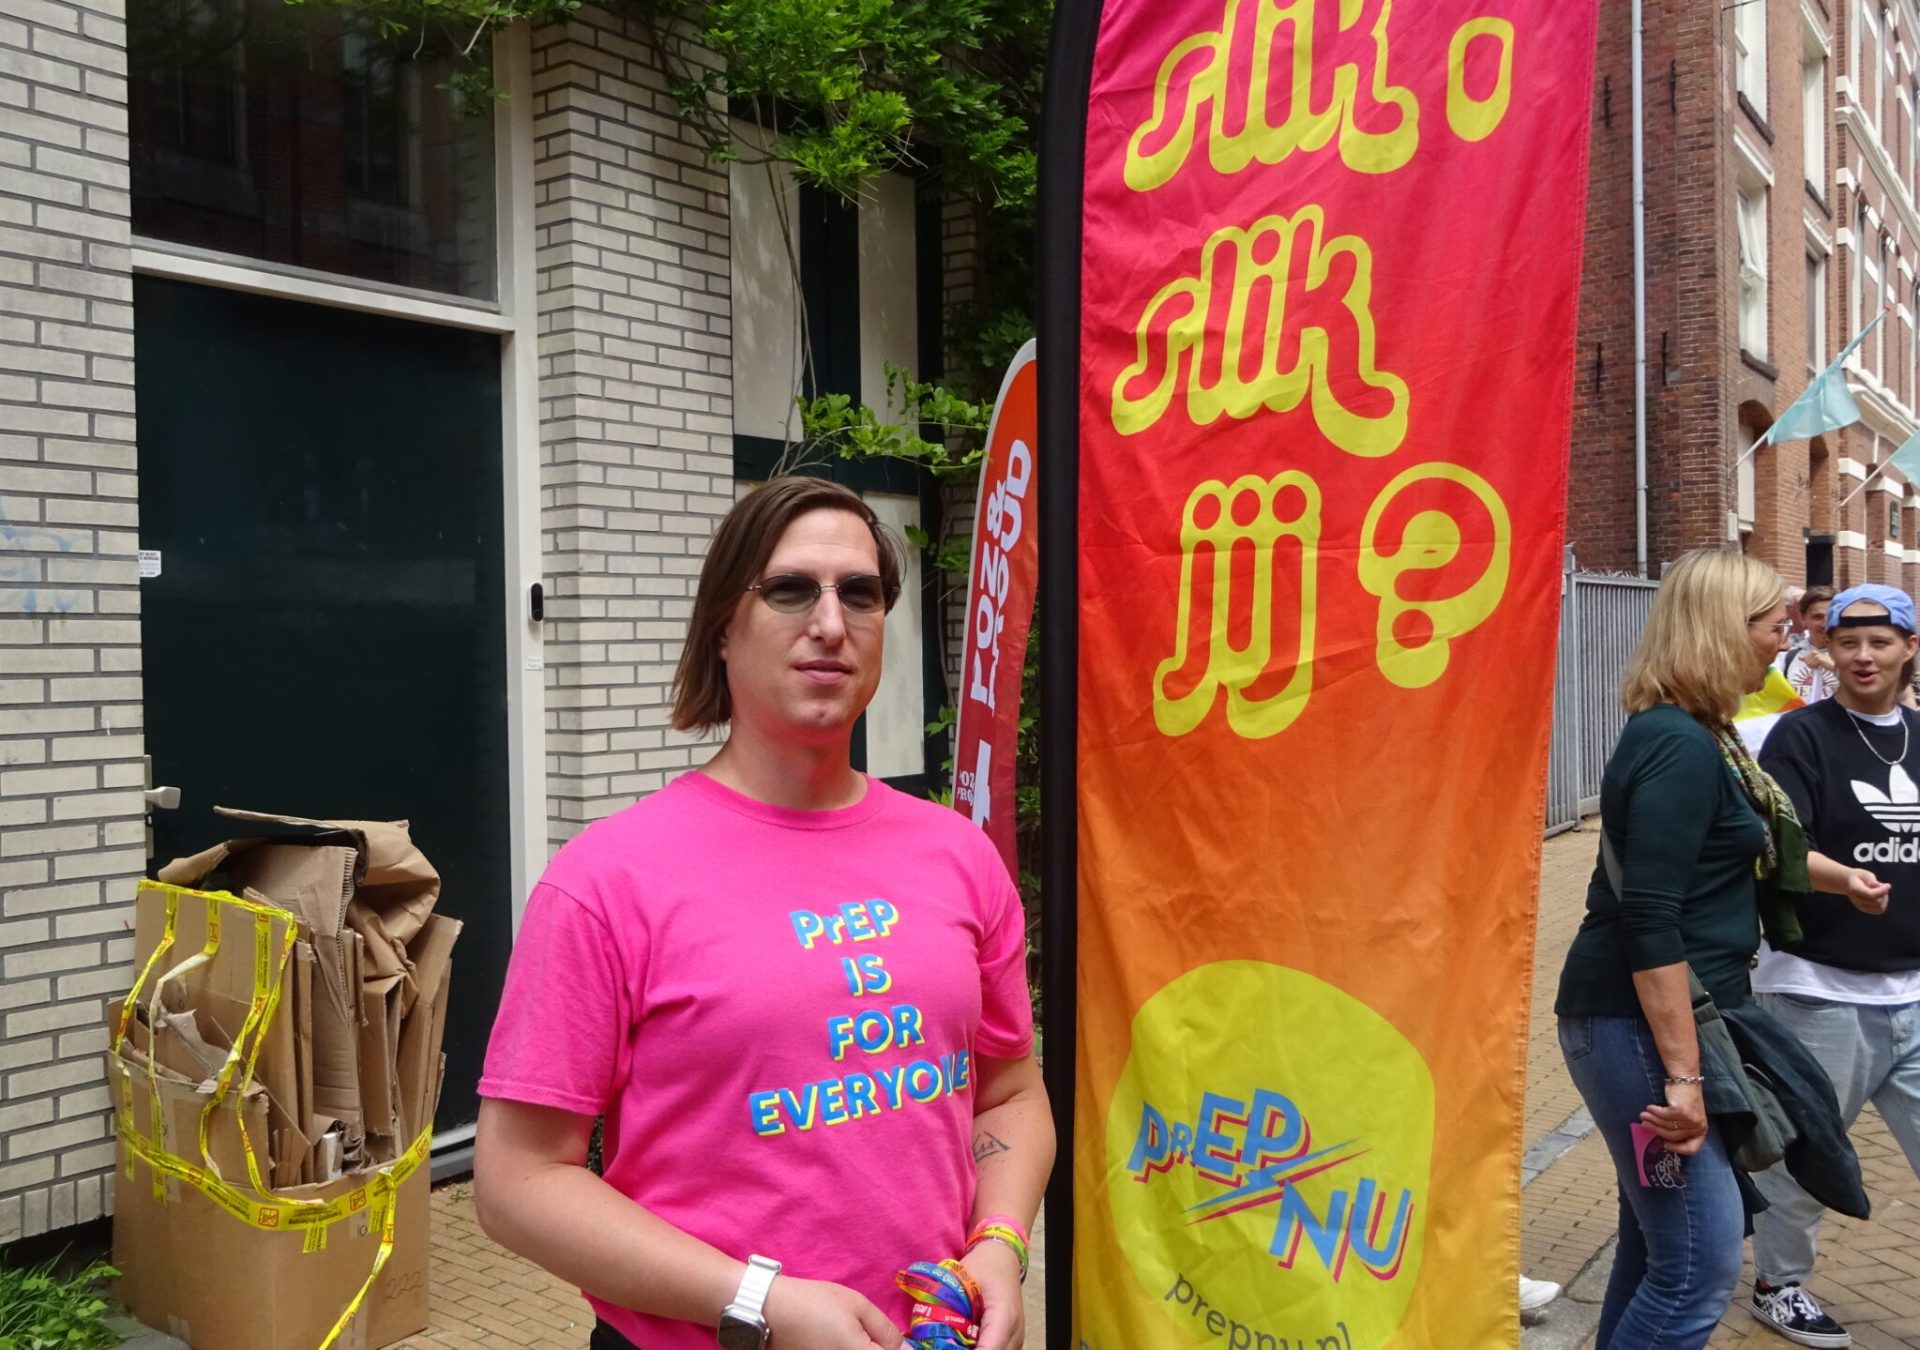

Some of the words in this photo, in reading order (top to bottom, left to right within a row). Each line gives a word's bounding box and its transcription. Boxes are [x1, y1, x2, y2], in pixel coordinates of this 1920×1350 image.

[1853, 836, 1920, 863] adid
[840, 954, 891, 997] IS
[827, 1004, 925, 1061] FOR
[1268, 1177, 1414, 1284] NU
[1164, 1272, 1351, 1350] prepnnl
